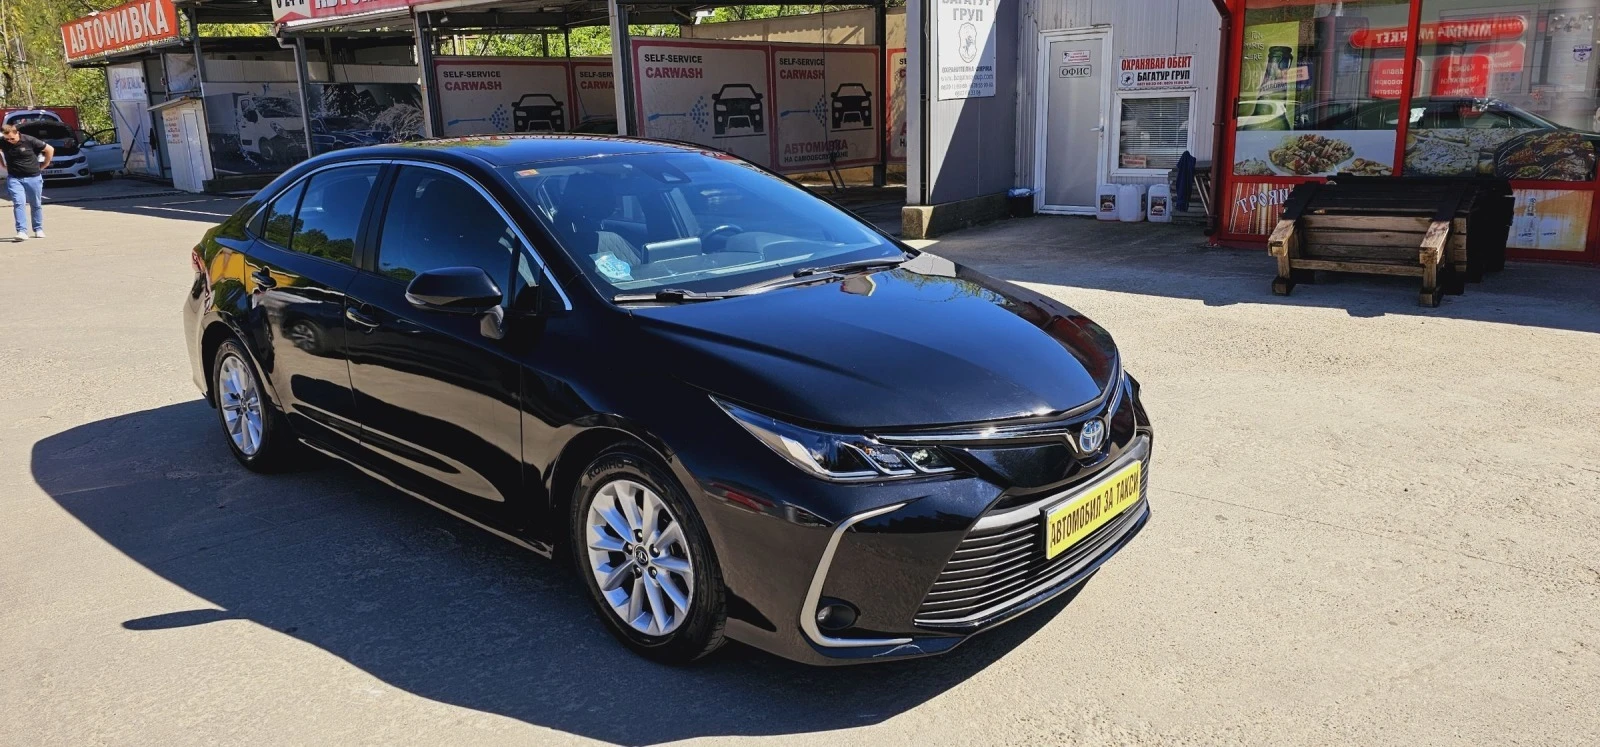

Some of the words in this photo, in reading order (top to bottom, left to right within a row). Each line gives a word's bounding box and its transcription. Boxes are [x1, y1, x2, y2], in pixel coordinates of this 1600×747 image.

[952, 8, 983, 21] ГРУП
[69, 1, 169, 54] АВТОМИВКА
[644, 53, 702, 63] SELF-SERVICE
[779, 58, 825, 66] SELF-SERVICE
[1121, 57, 1166, 71] ОХРАНЯВАН
[1167, 55, 1192, 69] ОБЕКТ
[443, 70, 501, 78] SELF-SERVICE
[645, 67, 703, 79] CARWASH
[779, 69, 825, 80] CARWASH
[1061, 68, 1090, 77] ОФИС
[1137, 70, 1170, 82] БАГАТУР
[1171, 69, 1190, 80] ГРУП
[445, 81, 502, 91] CARWASH
[784, 139, 848, 154] АВТОМИВКА
[794, 151, 848, 163] САМООБСЛУНЕ
[1051, 495, 1101, 545] АВТОМОБИЛ
[1104, 487, 1114, 513] ЗА
[1116, 471, 1139, 503] ТАКСИ
